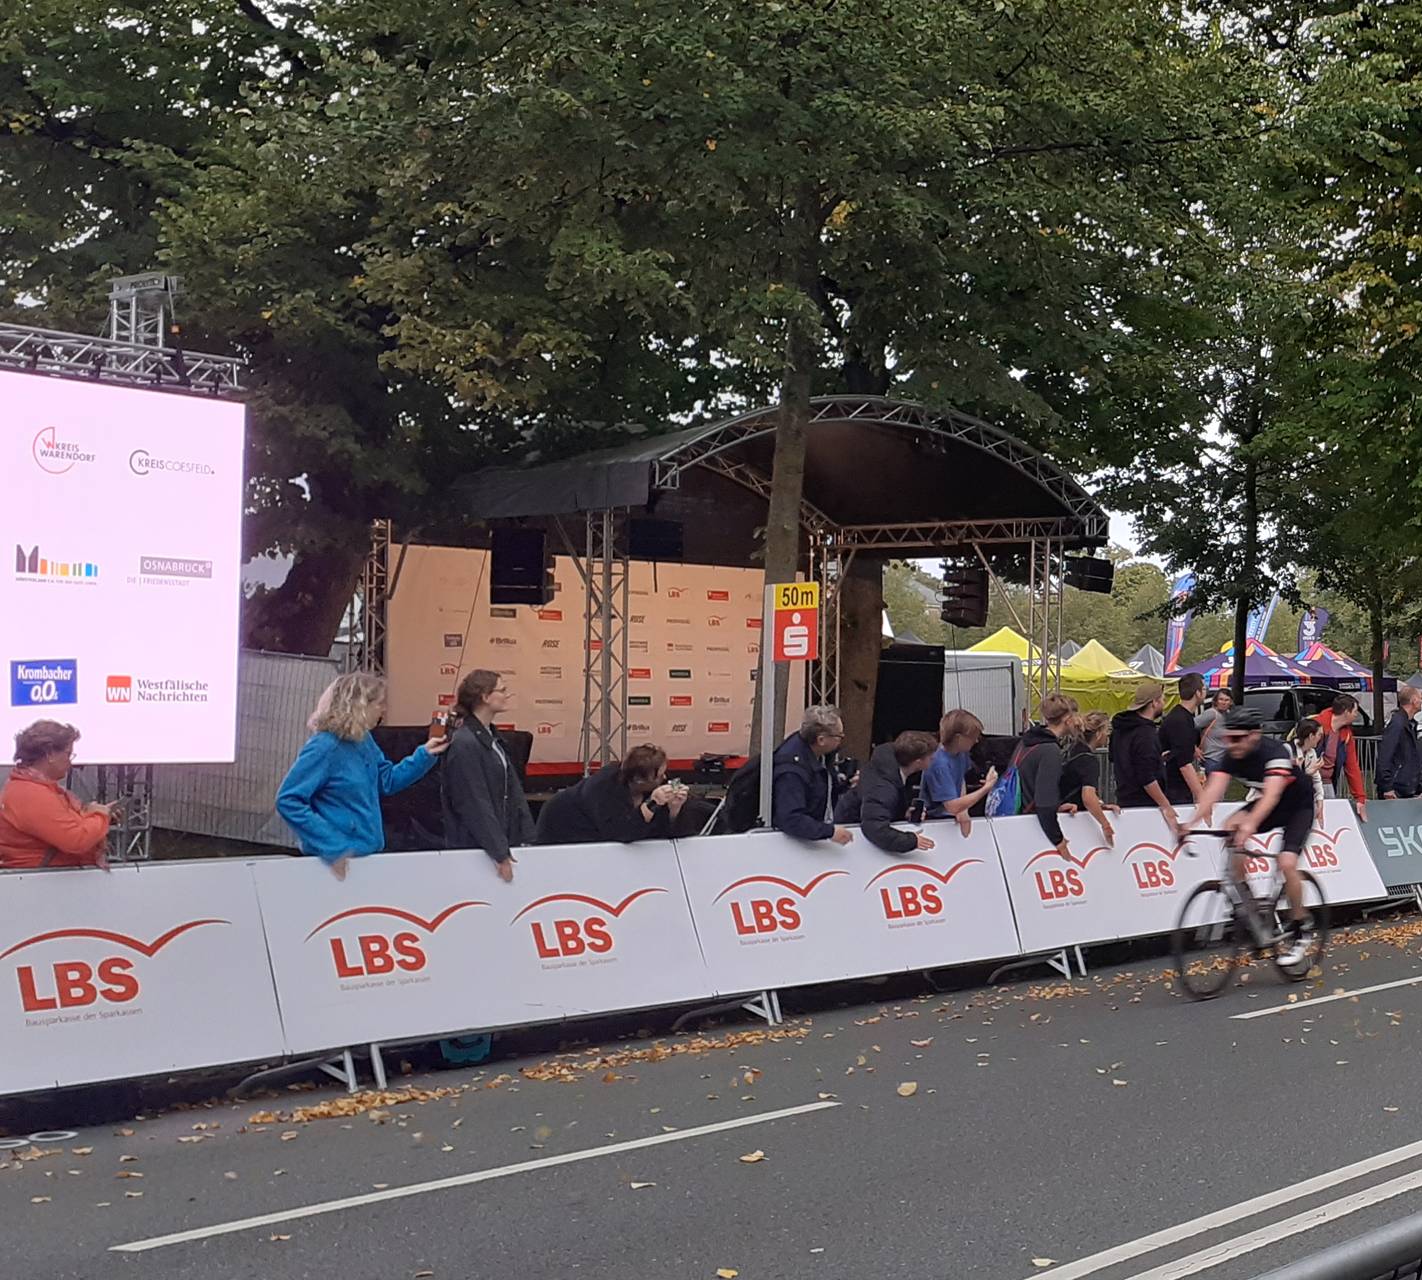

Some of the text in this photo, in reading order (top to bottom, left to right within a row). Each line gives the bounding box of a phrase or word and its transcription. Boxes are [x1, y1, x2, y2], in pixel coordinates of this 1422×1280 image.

[40, 449, 96, 462] WARENDORF
[56, 442, 79, 452] KREIS
[17, 665, 73, 680] Krombacher
[106, 679, 209, 701] WN Westfälische
[137, 691, 208, 703] Nachrichten
[1304, 844, 1338, 868] LBS
[1034, 868, 1084, 900] LBS
[1132, 860, 1174, 889] LBS
[880, 883, 943, 919] LBS
[730, 898, 801, 935] LBS
[530, 917, 613, 958] LBS
[330, 932, 426, 978] LBS
[16, 957, 140, 1012] LBS
[83, 1012, 97, 1020] der
